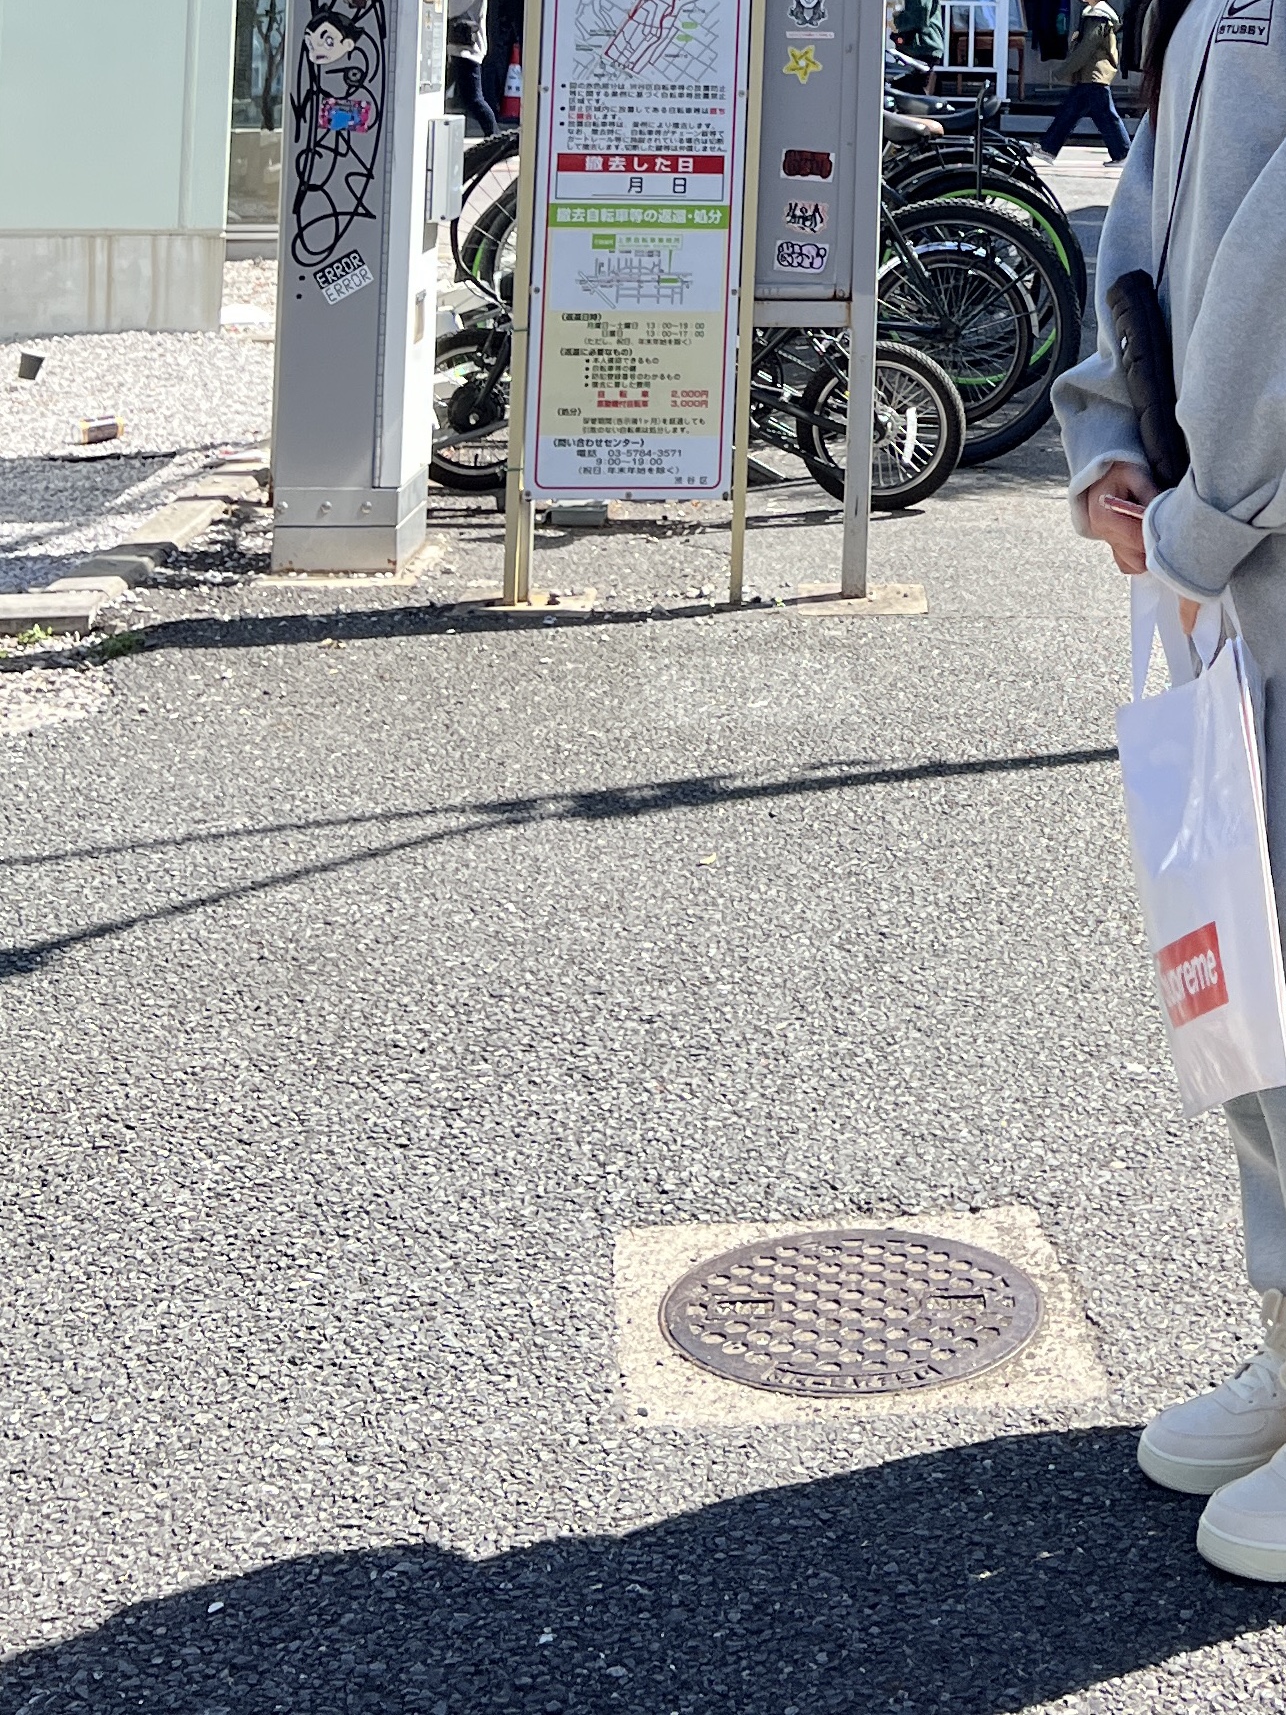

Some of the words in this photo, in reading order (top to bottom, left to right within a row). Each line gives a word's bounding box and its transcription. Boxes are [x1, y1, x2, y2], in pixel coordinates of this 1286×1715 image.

[584, 155, 694, 173] 撤去した日
[627, 176, 644, 194] 月
[672, 177, 687, 194] 日
[315, 252, 363, 288] ERROR
[324, 267, 372, 303] ERROR
